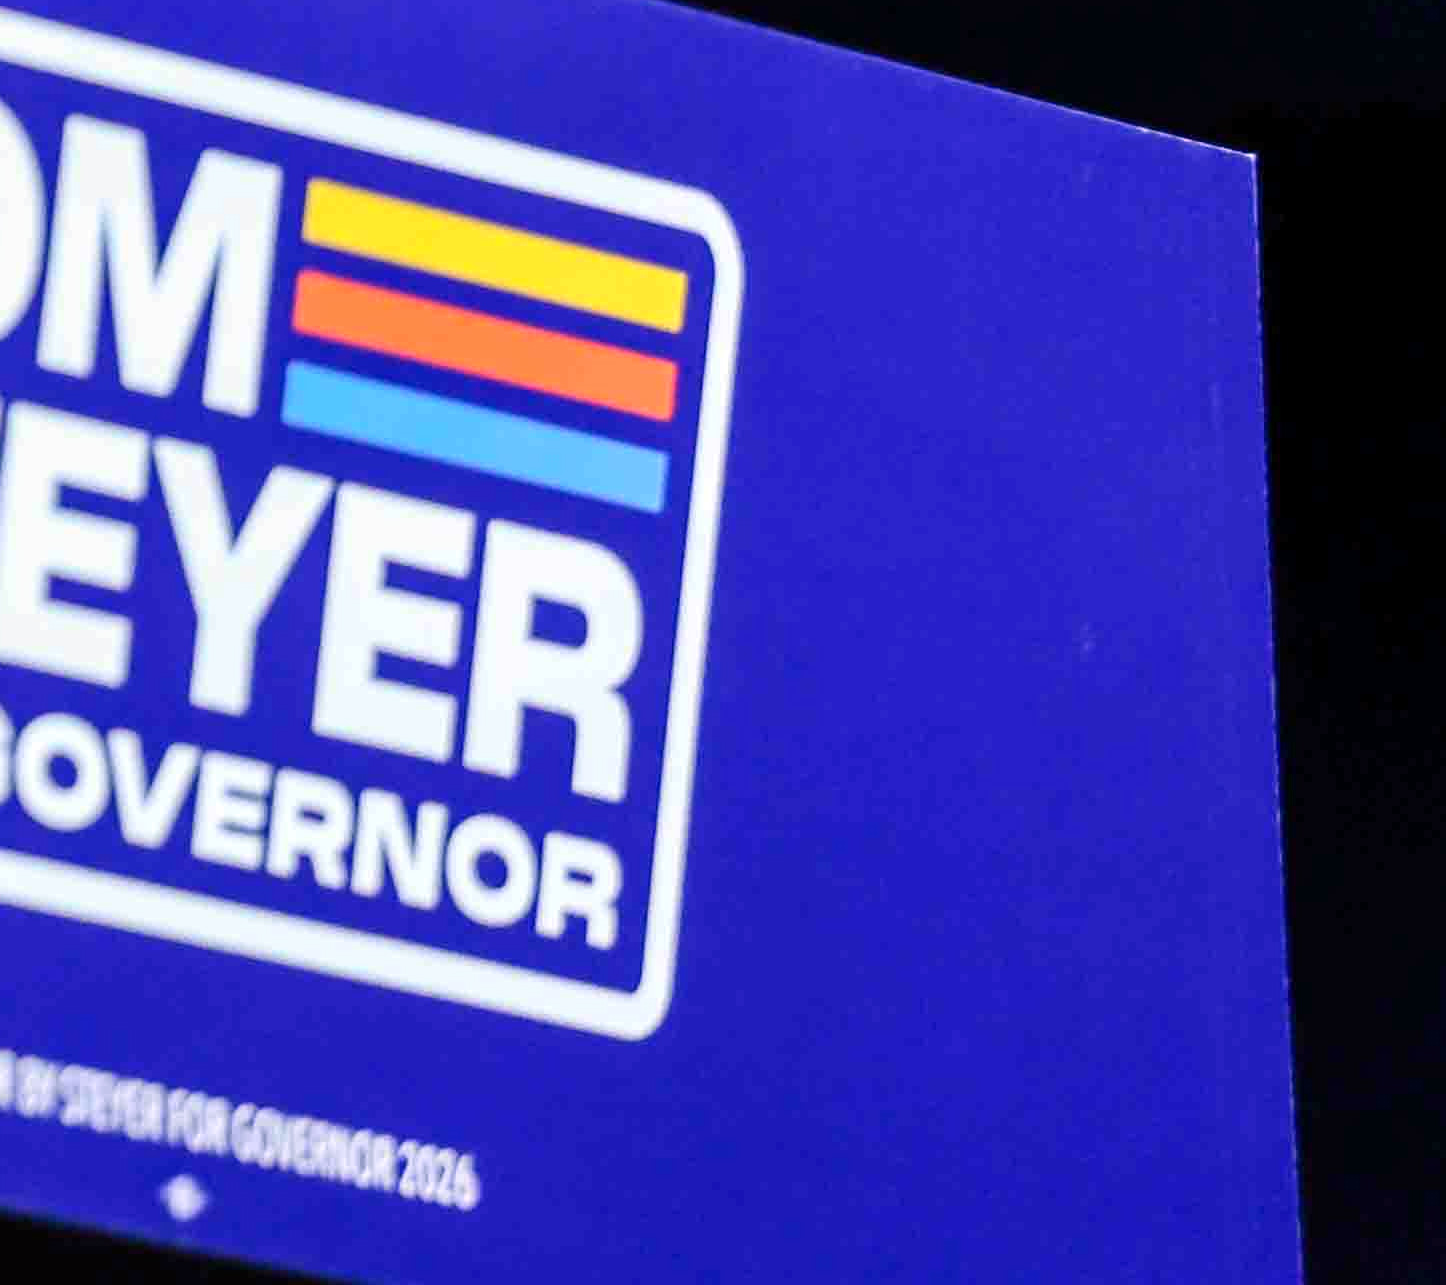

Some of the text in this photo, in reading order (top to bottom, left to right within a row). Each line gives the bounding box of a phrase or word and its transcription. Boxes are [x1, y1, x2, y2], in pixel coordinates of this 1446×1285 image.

[58, 1063, 166, 1142] STEYER
[166, 1087, 232, 1157] FOR
[231, 1102, 397, 1193] GOVERNOR
[398, 1138, 480, 1211] 2026
